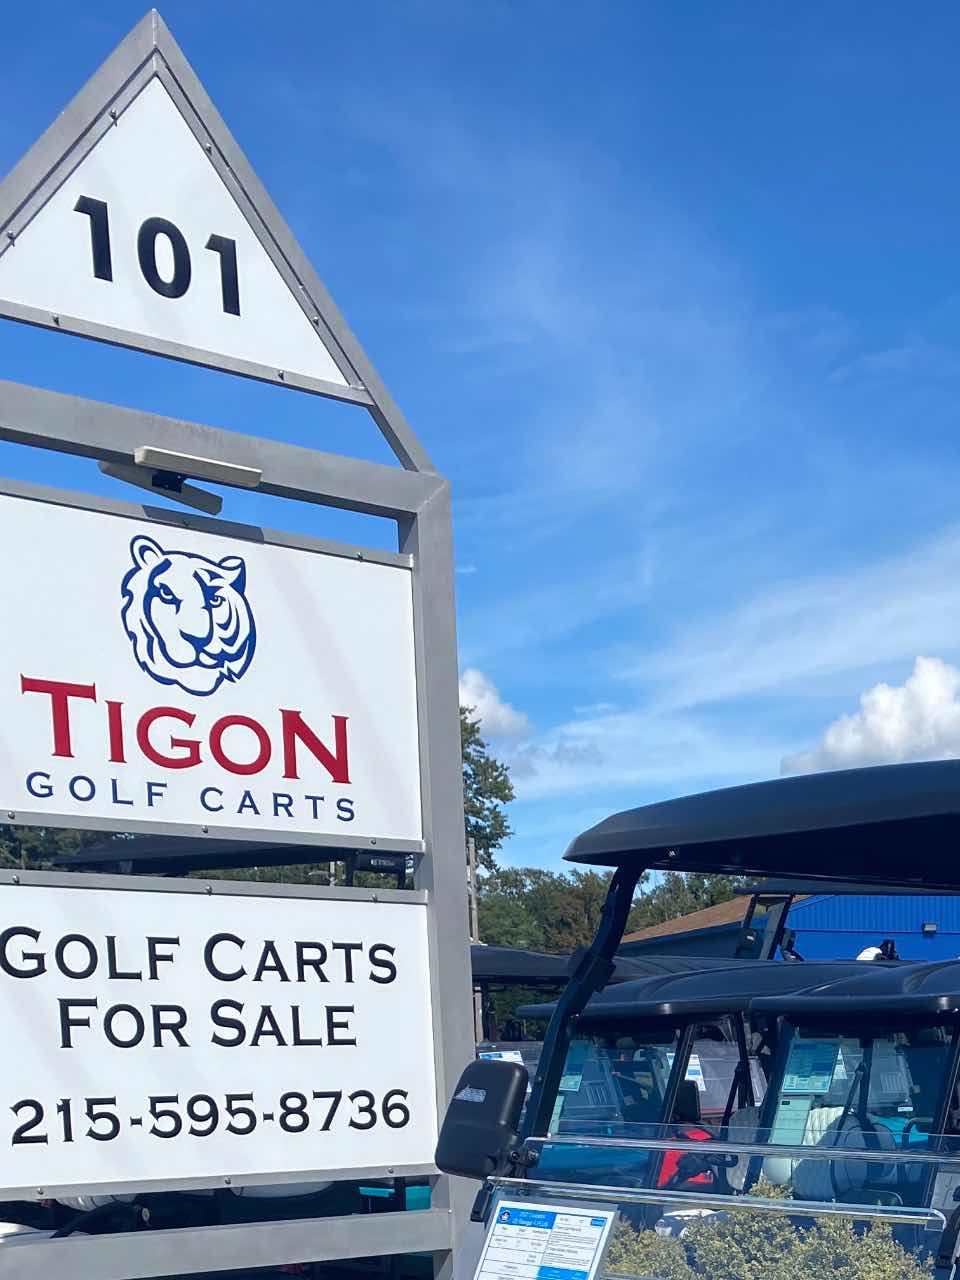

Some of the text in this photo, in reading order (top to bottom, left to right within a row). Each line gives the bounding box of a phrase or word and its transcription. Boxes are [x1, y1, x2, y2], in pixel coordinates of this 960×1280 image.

[73, 194, 241, 317] 101
[20, 673, 352, 785] TIGON
[25, 771, 355, 822] GOLF CARTS
[0, 926, 397, 985] GOLF CARTS
[57, 996, 357, 1049] FOR SALE
[9, 1088, 410, 1147] 215-595-8736
